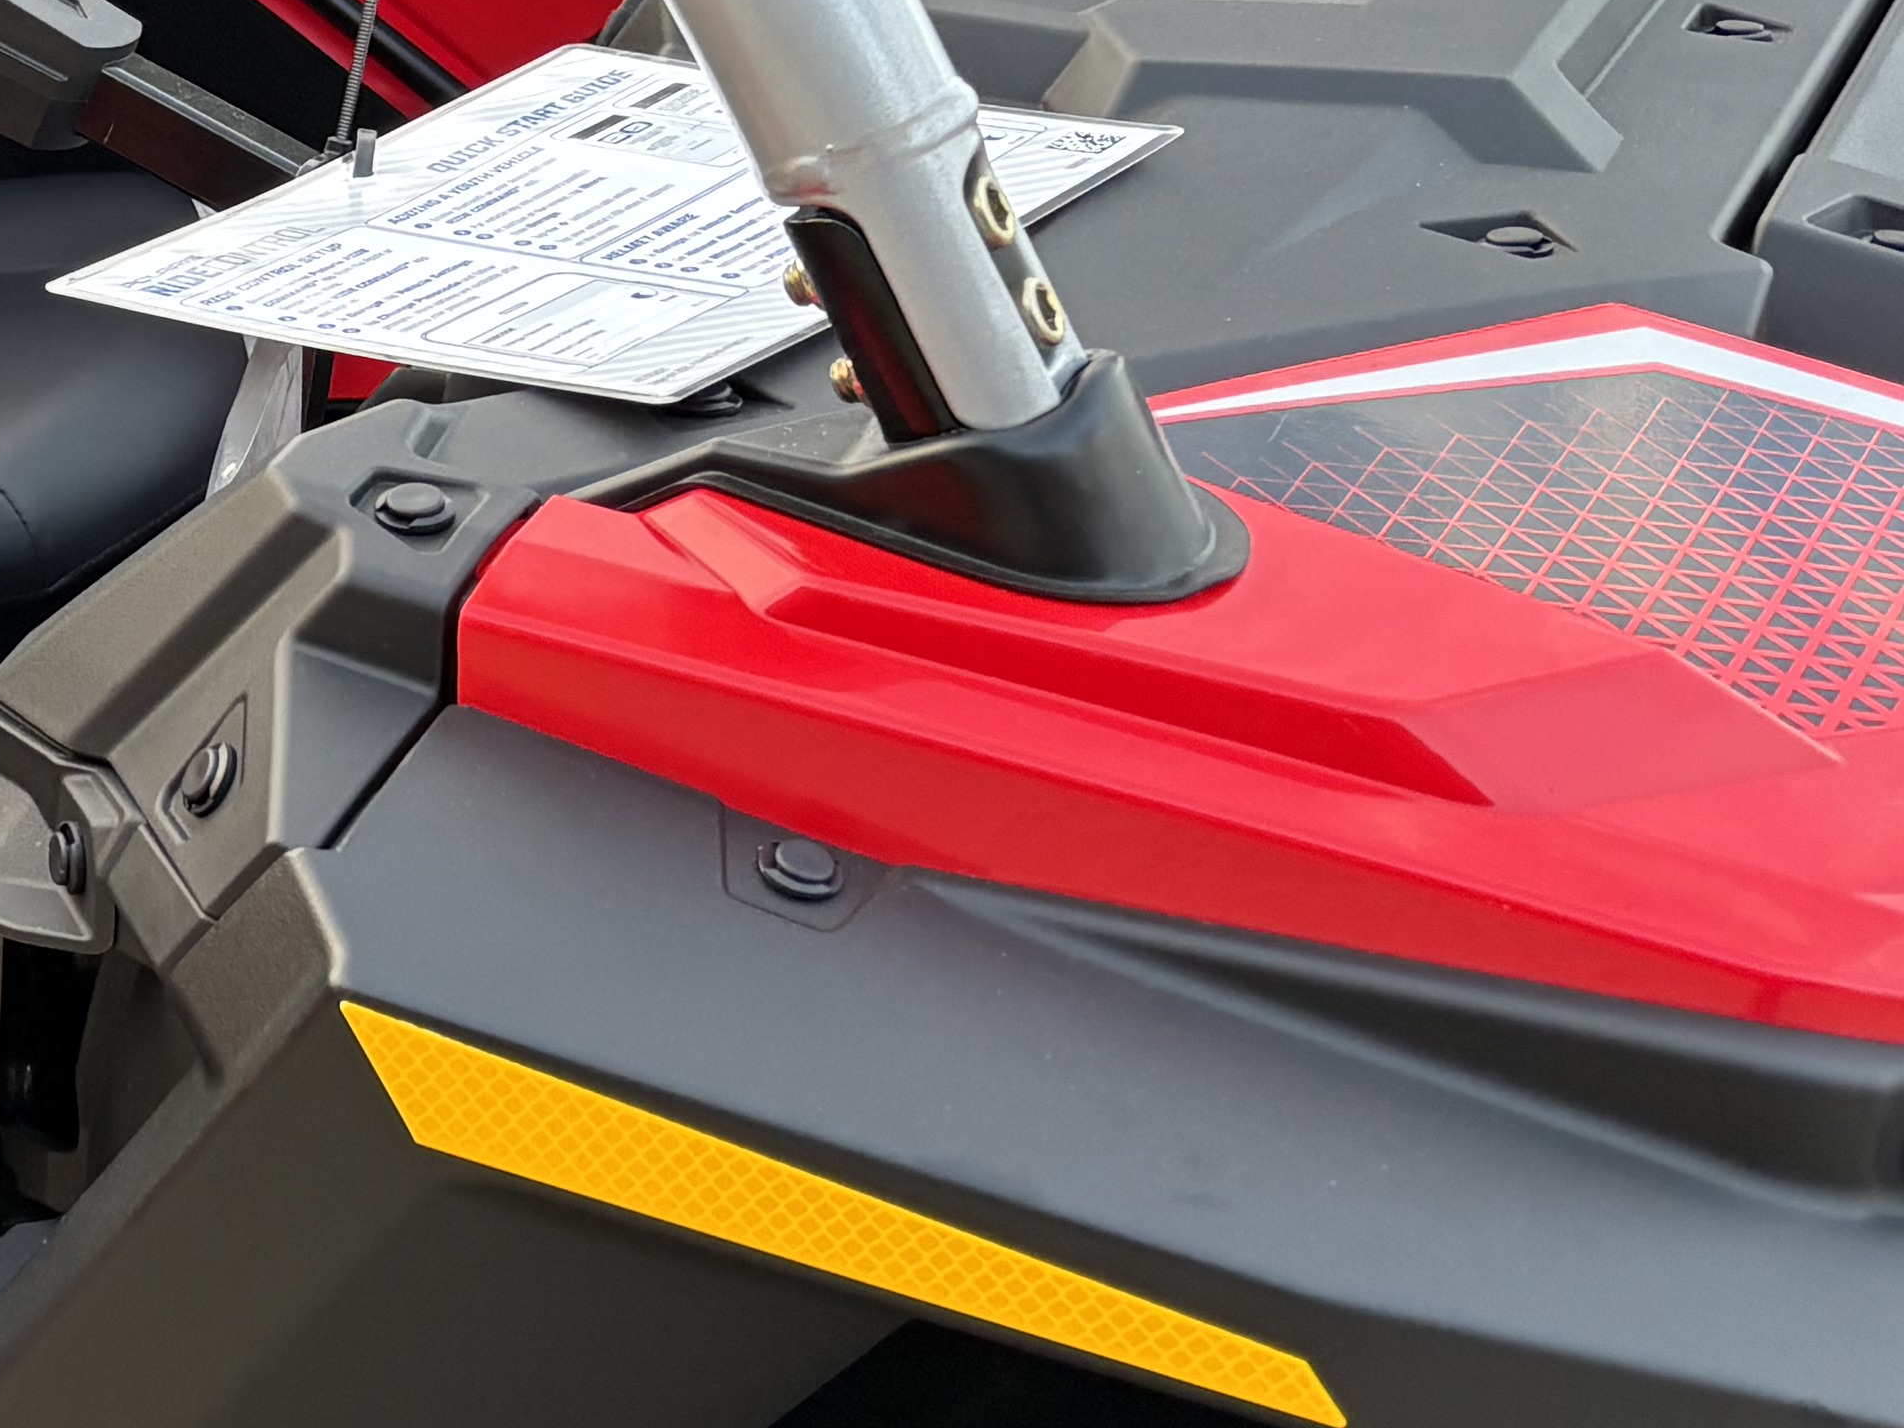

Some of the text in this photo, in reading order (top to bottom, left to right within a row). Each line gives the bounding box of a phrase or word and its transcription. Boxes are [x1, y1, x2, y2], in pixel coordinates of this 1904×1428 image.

[426, 136, 504, 173] QUICK
[496, 102, 566, 137] START
[560, 69, 632, 104] GUIDE
